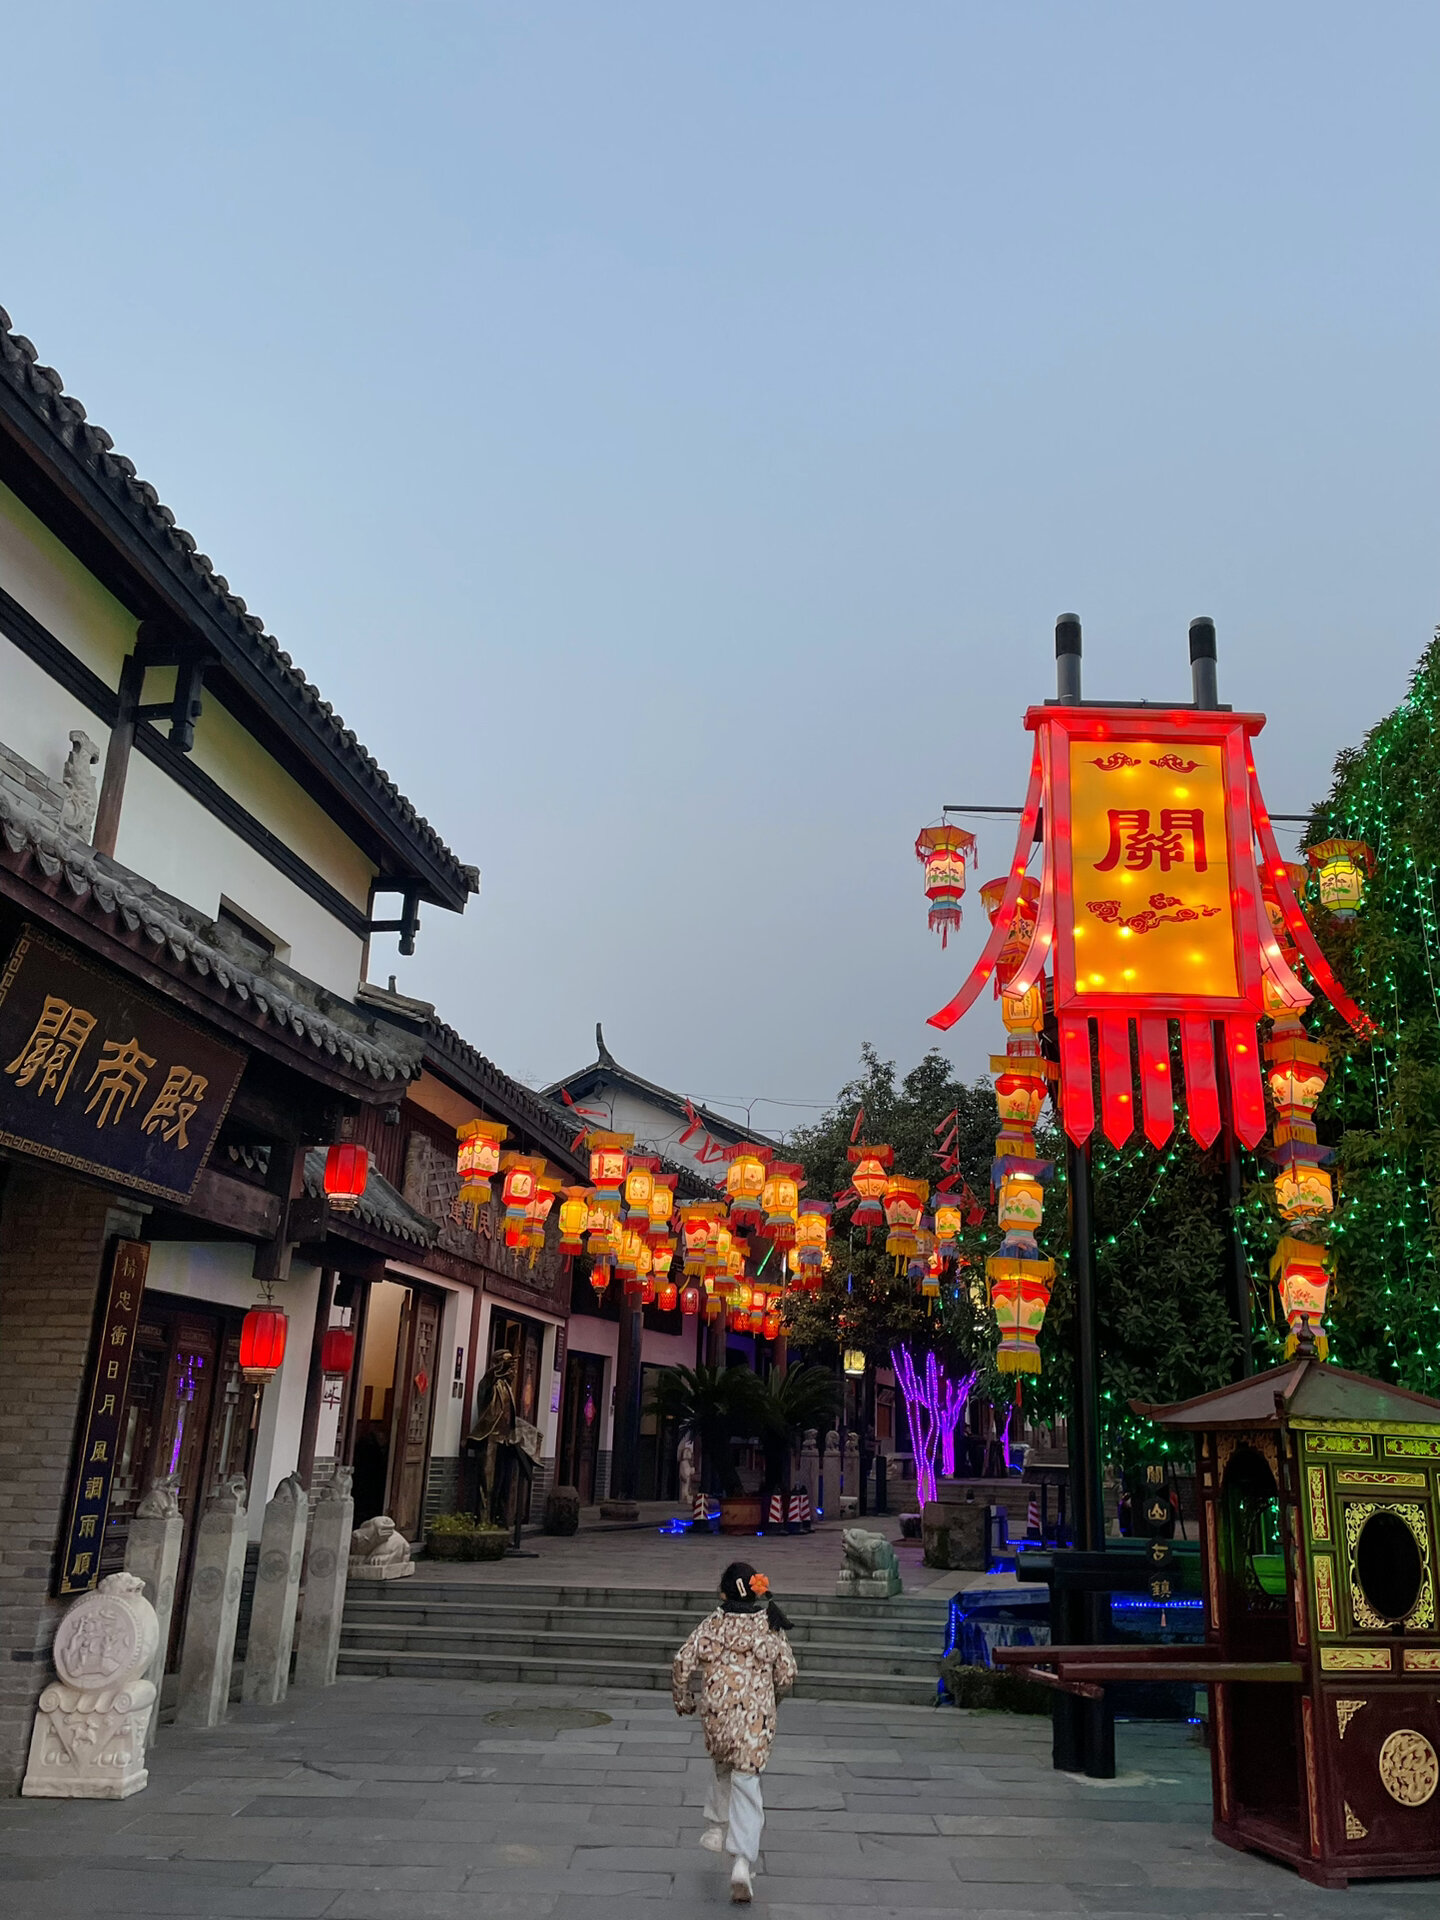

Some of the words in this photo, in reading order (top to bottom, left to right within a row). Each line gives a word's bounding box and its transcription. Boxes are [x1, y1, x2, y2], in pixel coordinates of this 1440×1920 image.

[1093, 809, 1208, 872] 關
[5, 993, 209, 1150] 關帝殿
